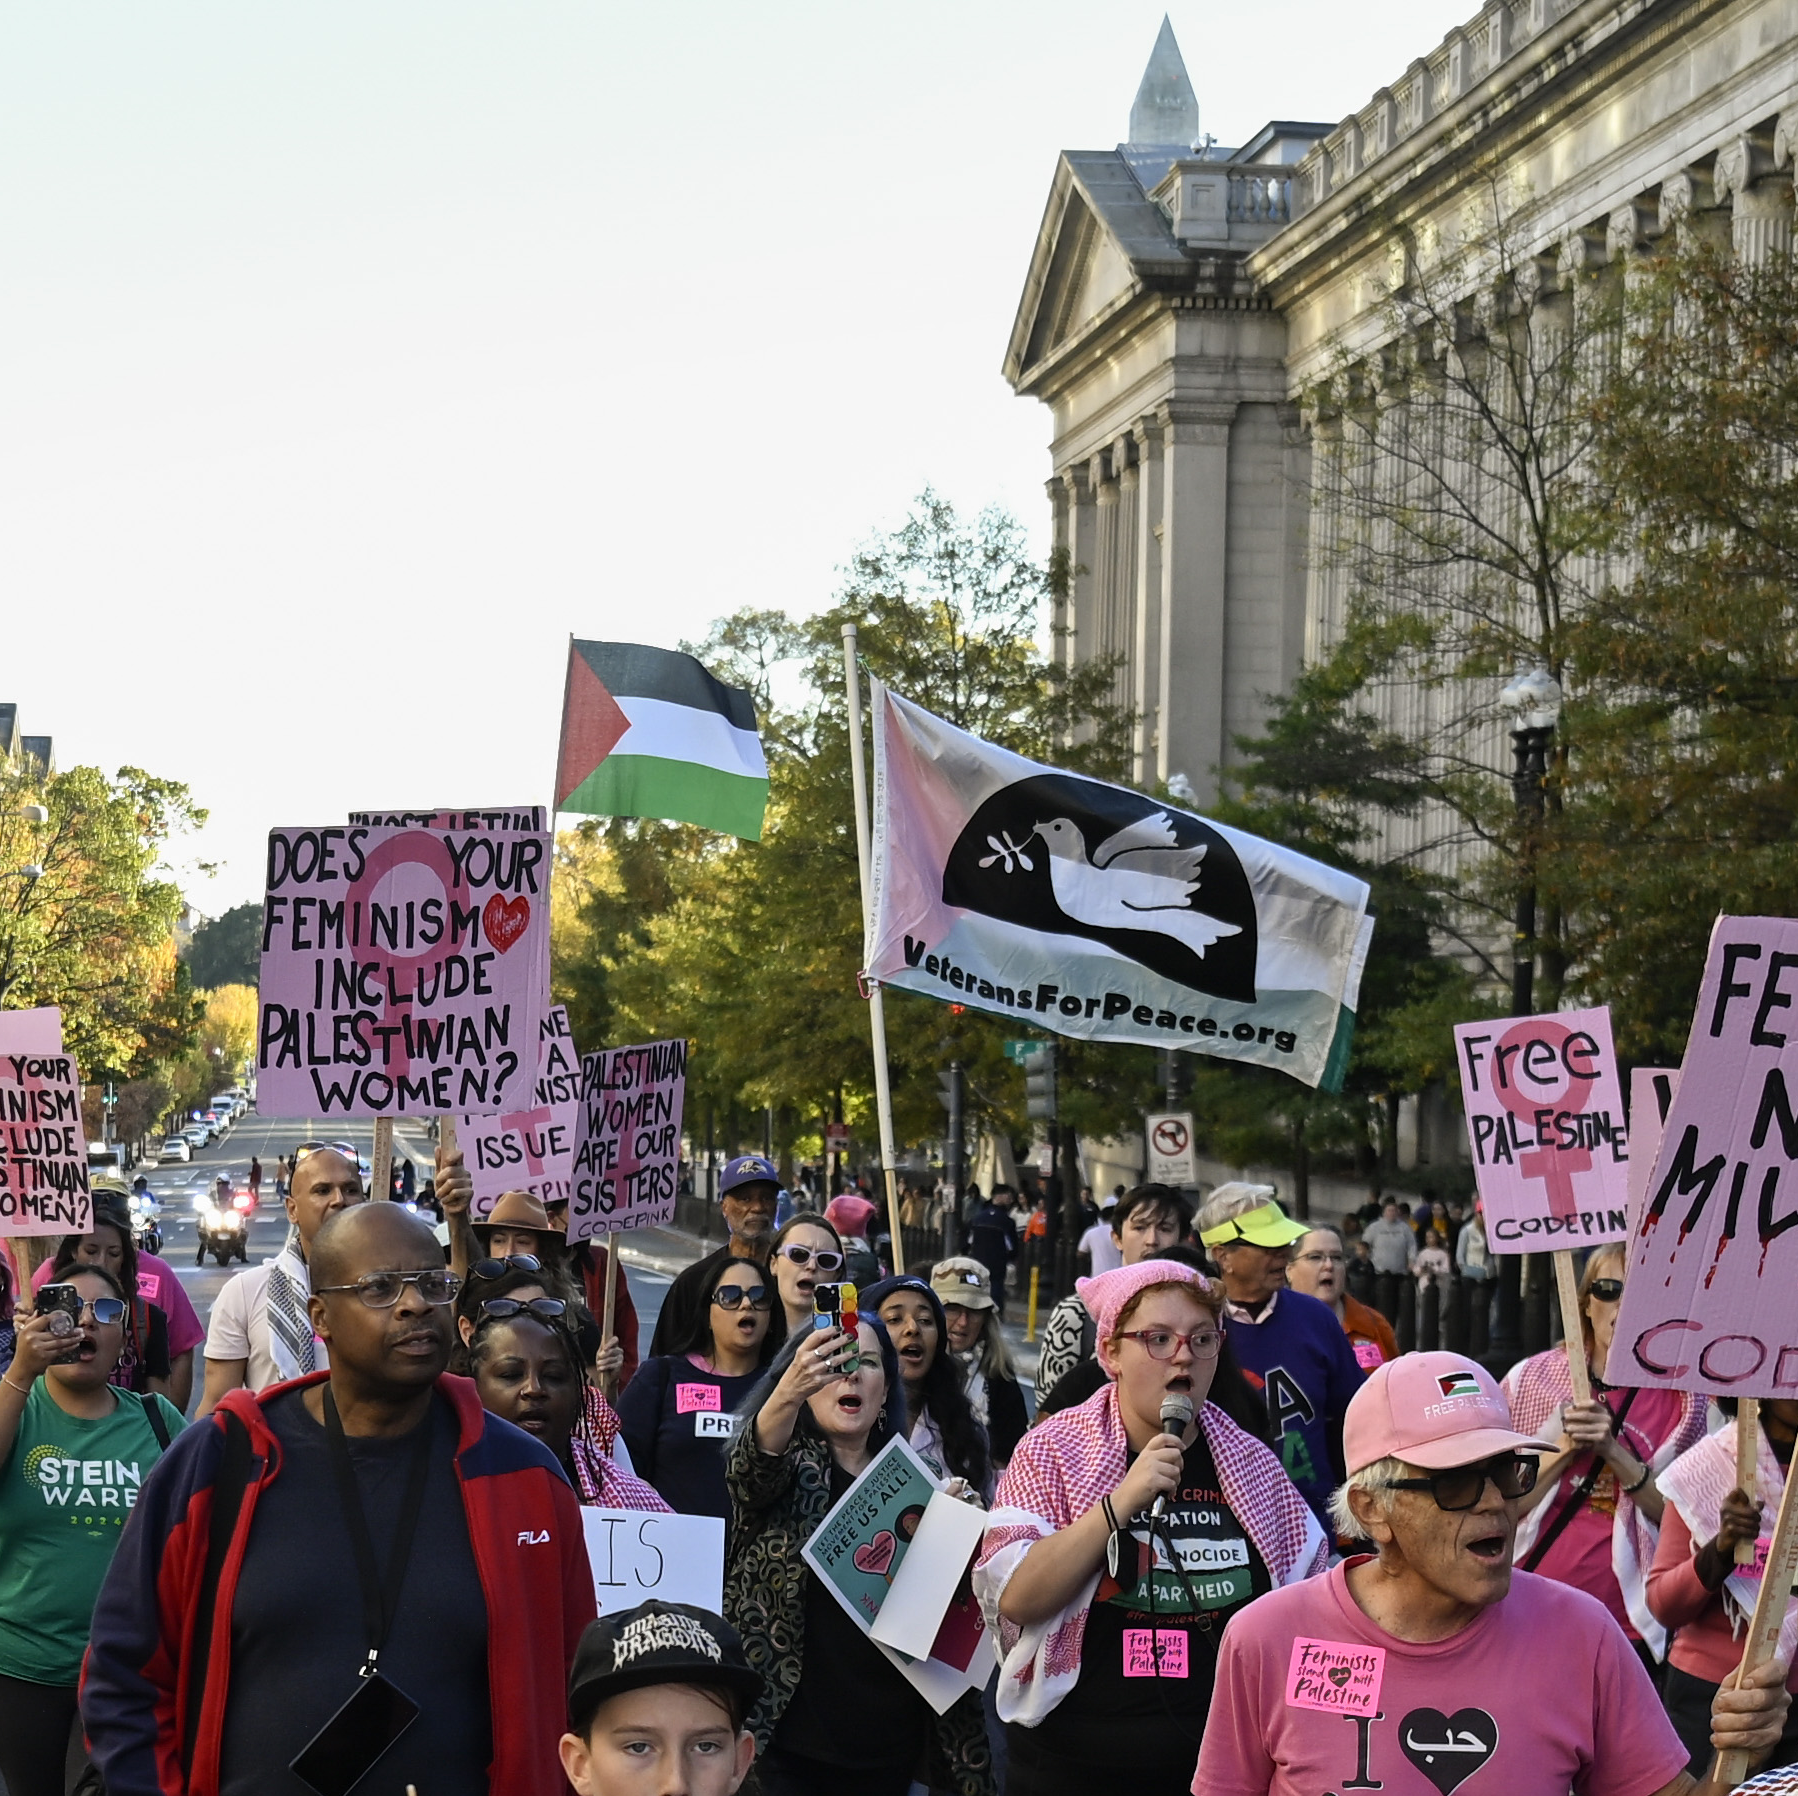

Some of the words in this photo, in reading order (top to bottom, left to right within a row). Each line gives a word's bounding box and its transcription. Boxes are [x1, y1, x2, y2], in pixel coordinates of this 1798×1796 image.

[268, 829, 369, 891] DOES
[443, 836, 543, 895] YOUR
[262, 895, 480, 952] FEMINISM
[314, 952, 495, 1010] INCLUDE
[904, 935, 1297, 1053] VeteransForPeace.org
[260, 1003, 510, 1069] PALESTINIAN
[547, 1043, 569, 1075] A
[1463, 1031, 1602, 1092] Free
[8, 1055, 71, 1086] YOUR
[310, 1051, 518, 1113] WOMEN?
[581, 1040, 687, 1102] PALESTINIAN
[588, 1088, 673, 1139] WOMEN
[1471, 1109, 1629, 1164] PALESTINE
[476, 1126, 570, 1170] ISSUE
[573, 1139, 619, 1177] ARE
[635, 1124, 677, 1160] OUR
[578, 1207, 670, 1238] CODEPINK
[1496, 1204, 1629, 1240] CODEPIN
[703, 1417, 731, 1433] PR
[1424, 1400, 1456, 1420] FREE
[38, 1458, 141, 1487] STEIN
[817, 1536, 829, 1552] LET
[828, 1520, 842, 1536] THE
[841, 1494, 864, 1520] PEACE
[870, 1456, 898, 1486] JUSTICE
[821, 1515, 855, 1556] MOVEMENT
[854, 1500, 869, 1515] FOR
[868, 1462, 902, 1499] PALESTINE
[826, 1526, 859, 1567] FREE
[857, 1503, 879, 1528] US
[880, 1468, 913, 1506] ALL!
[517, 1530, 550, 1546] FILA
[598, 1518, 664, 1588] IS
[1296, 1666, 1325, 1680] stand
[1353, 1674, 1374, 1688] with
[1300, 1643, 1377, 1673] Feminists
[1294, 1677, 1371, 1707] Palestine
